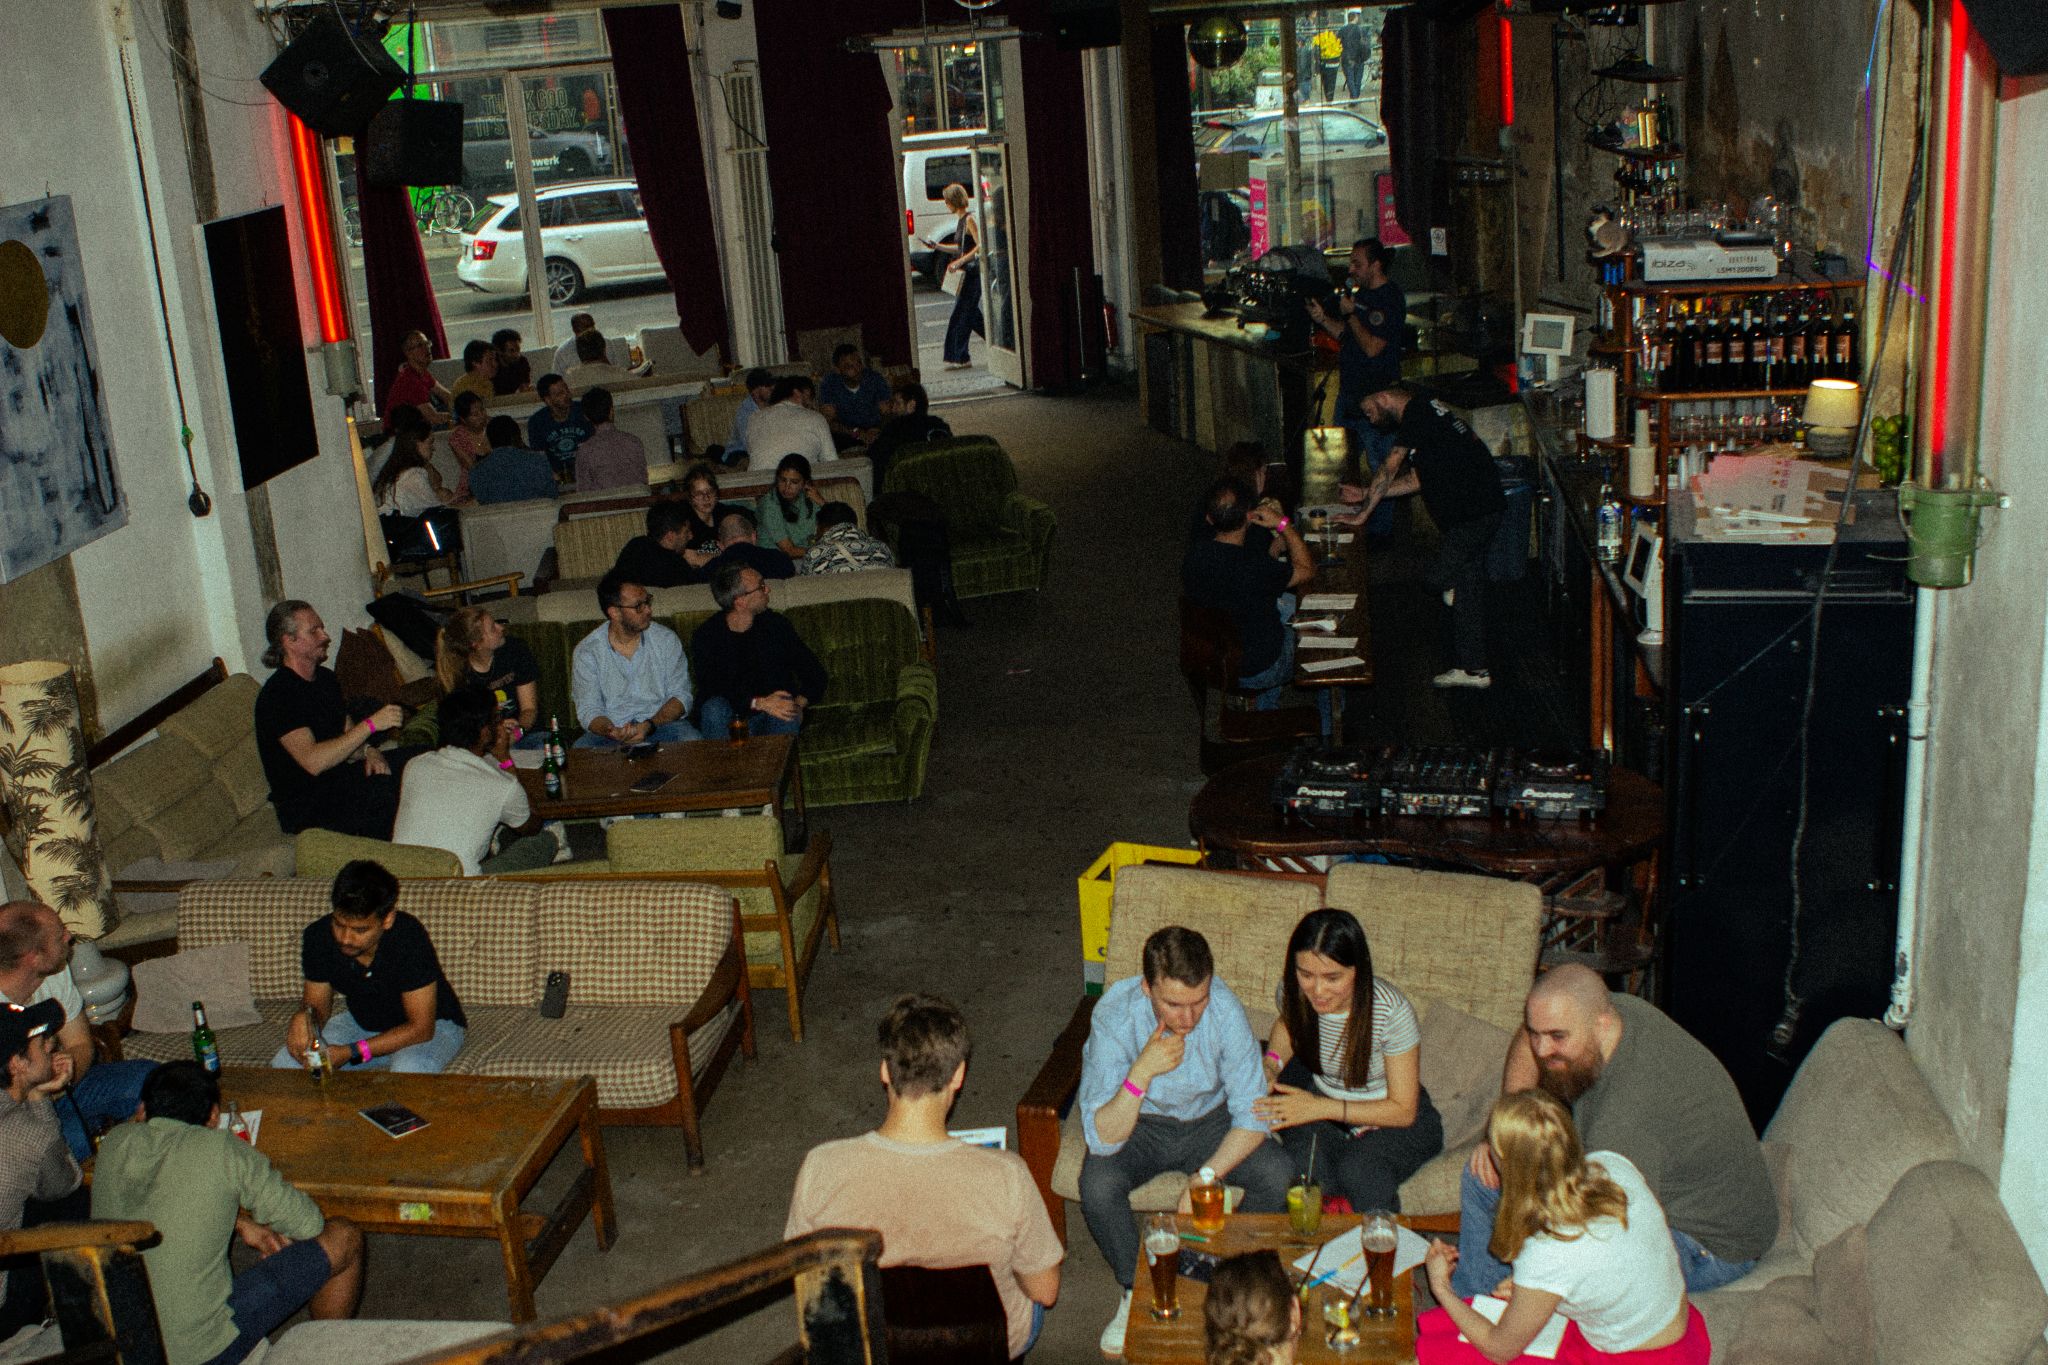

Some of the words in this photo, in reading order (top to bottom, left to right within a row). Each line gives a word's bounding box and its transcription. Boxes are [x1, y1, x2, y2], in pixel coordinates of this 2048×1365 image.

[481, 89, 536, 115] THK
[537, 87, 568, 110] GOD
[1297, 786, 1348, 797] Pioneer
[1522, 788, 1575, 799] Pioneer
